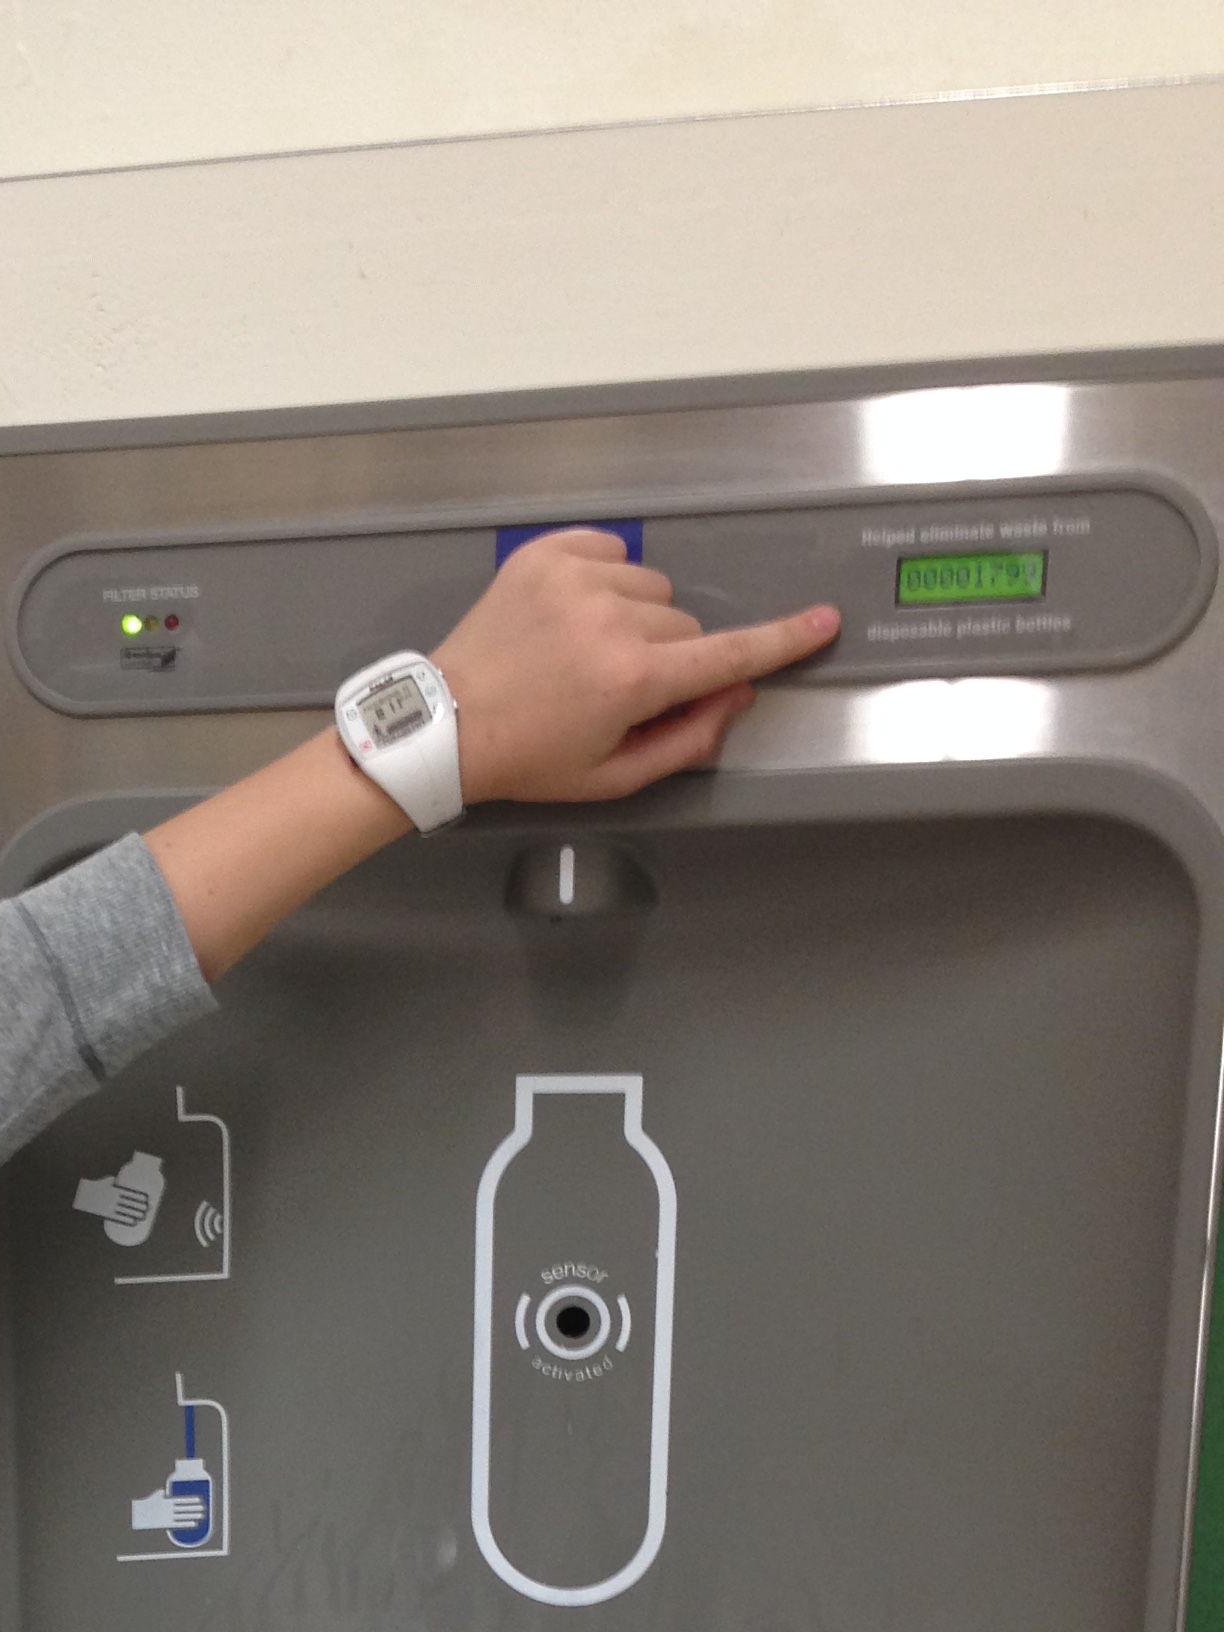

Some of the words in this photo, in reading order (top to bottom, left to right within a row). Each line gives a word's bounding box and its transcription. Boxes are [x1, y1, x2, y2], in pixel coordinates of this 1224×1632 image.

[861, 528, 915, 547] Helped
[920, 524, 994, 543] eliminate
[999, 519, 1047, 538] waste
[1053, 516, 1090, 535] from
[103, 589, 146, 602] FILTER
[150, 586, 199, 600] STATUS
[867, 618, 952, 642] disposable
[957, 616, 1011, 640] plastic
[1015, 613, 1071, 634] bottles
[541, 1261, 609, 1284] sensor
[531, 1354, 614, 1382] activated
